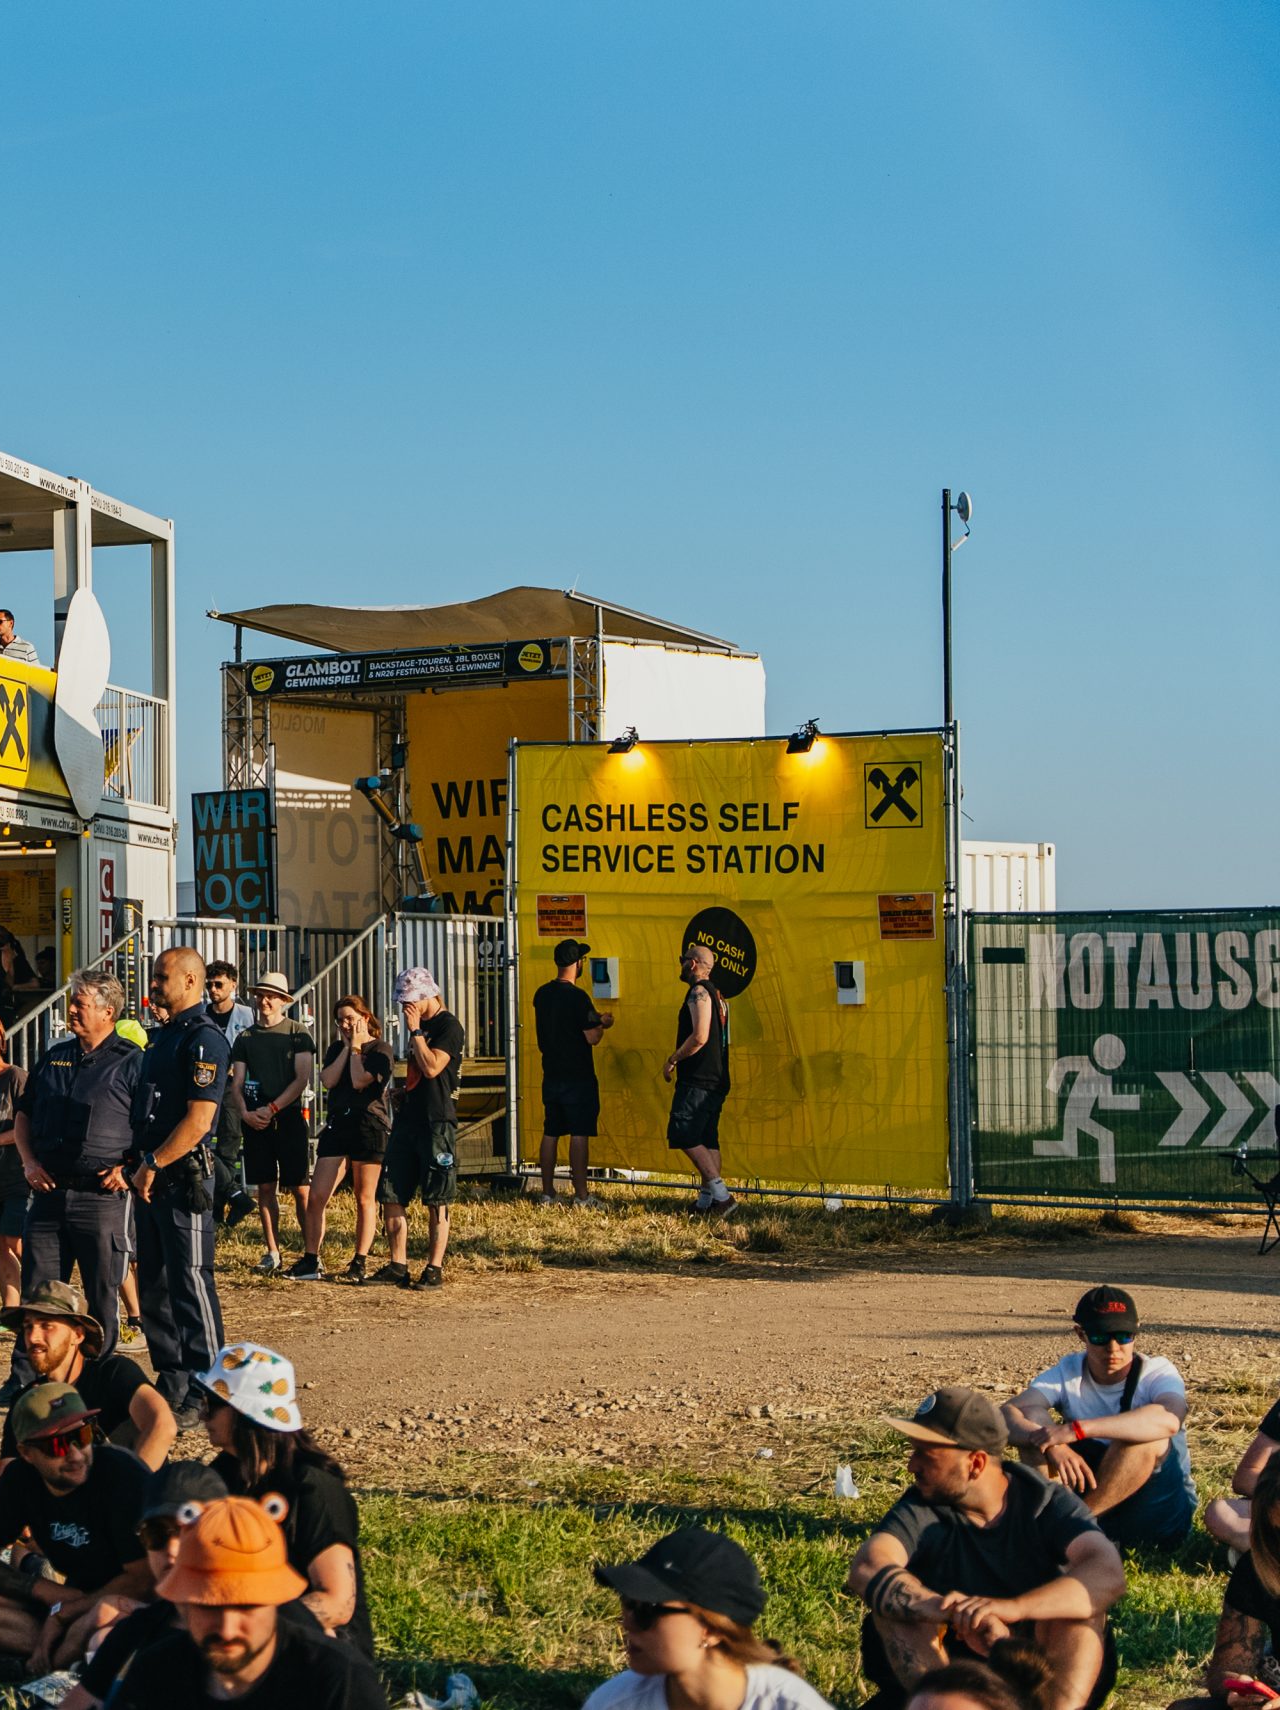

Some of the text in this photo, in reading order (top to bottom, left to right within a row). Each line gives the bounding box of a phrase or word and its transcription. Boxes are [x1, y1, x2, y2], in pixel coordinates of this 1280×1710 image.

[40, 477, 76, 499] www.chv.at
[454, 655, 470, 664] JBL
[471, 652, 500, 662] BOXEN
[521, 651, 542, 659] JETZT
[286, 660, 361, 678] GLAMBOT
[375, 669, 394, 678] NR26
[396, 663, 454, 677] FESTIVALPÄSSE
[455, 662, 500, 672] GEWINNEN!
[285, 674, 361, 688] GEWINNSPIEL!
[195, 790, 266, 831] WIR
[541, 802, 800, 833] CASHLESS SELF
[40, 816, 78, 832] www.chv.at
[138, 832, 169, 847] www.chv.at
[541, 843, 826, 874] SERVICE STATION
[697, 930, 745, 962] NO CASH
[720, 957, 749, 977] ONLY
